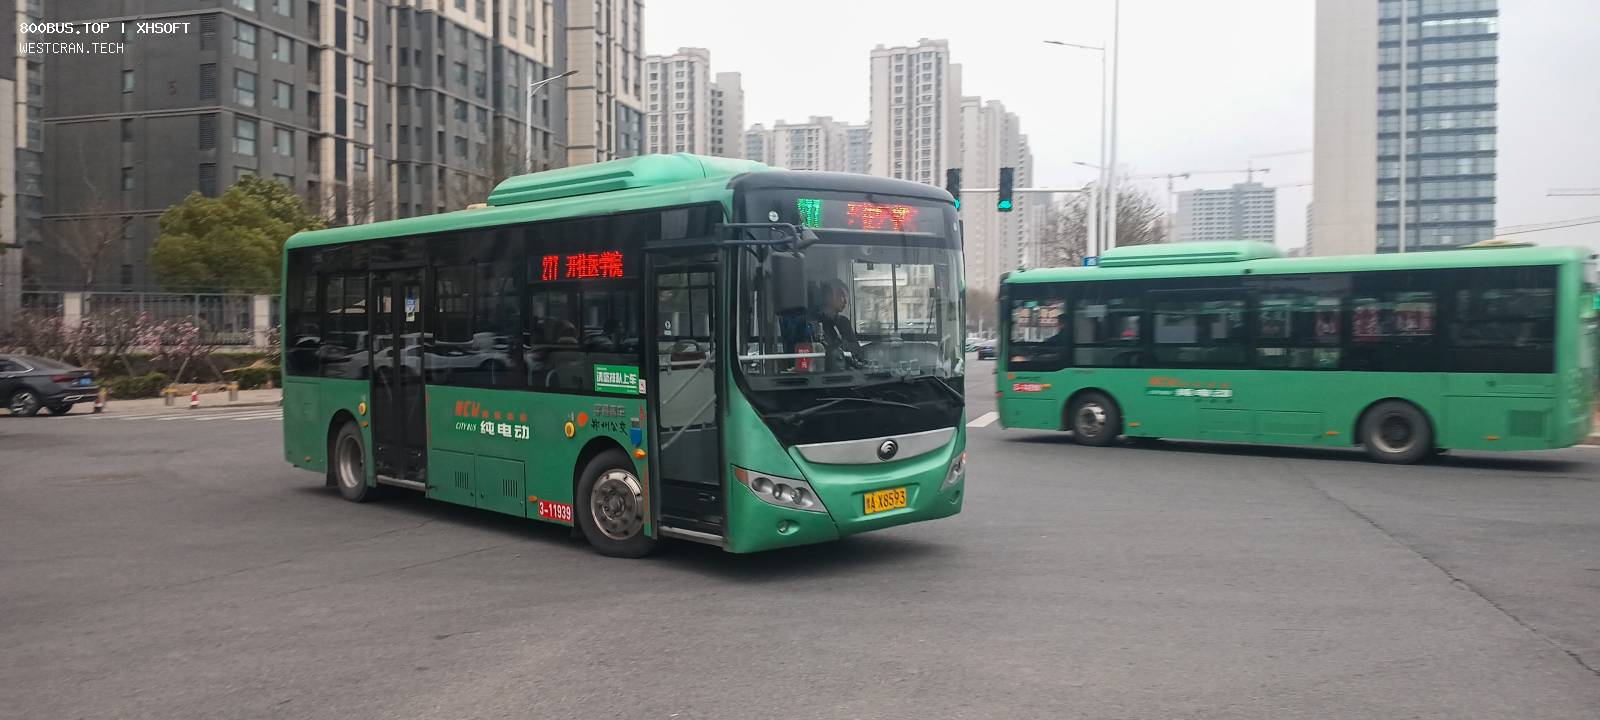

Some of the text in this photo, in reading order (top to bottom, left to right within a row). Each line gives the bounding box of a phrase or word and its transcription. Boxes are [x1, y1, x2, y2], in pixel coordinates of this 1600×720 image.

[480, 420, 530, 440] 纯电动
[539, 500, 571, 521] 3-11939
